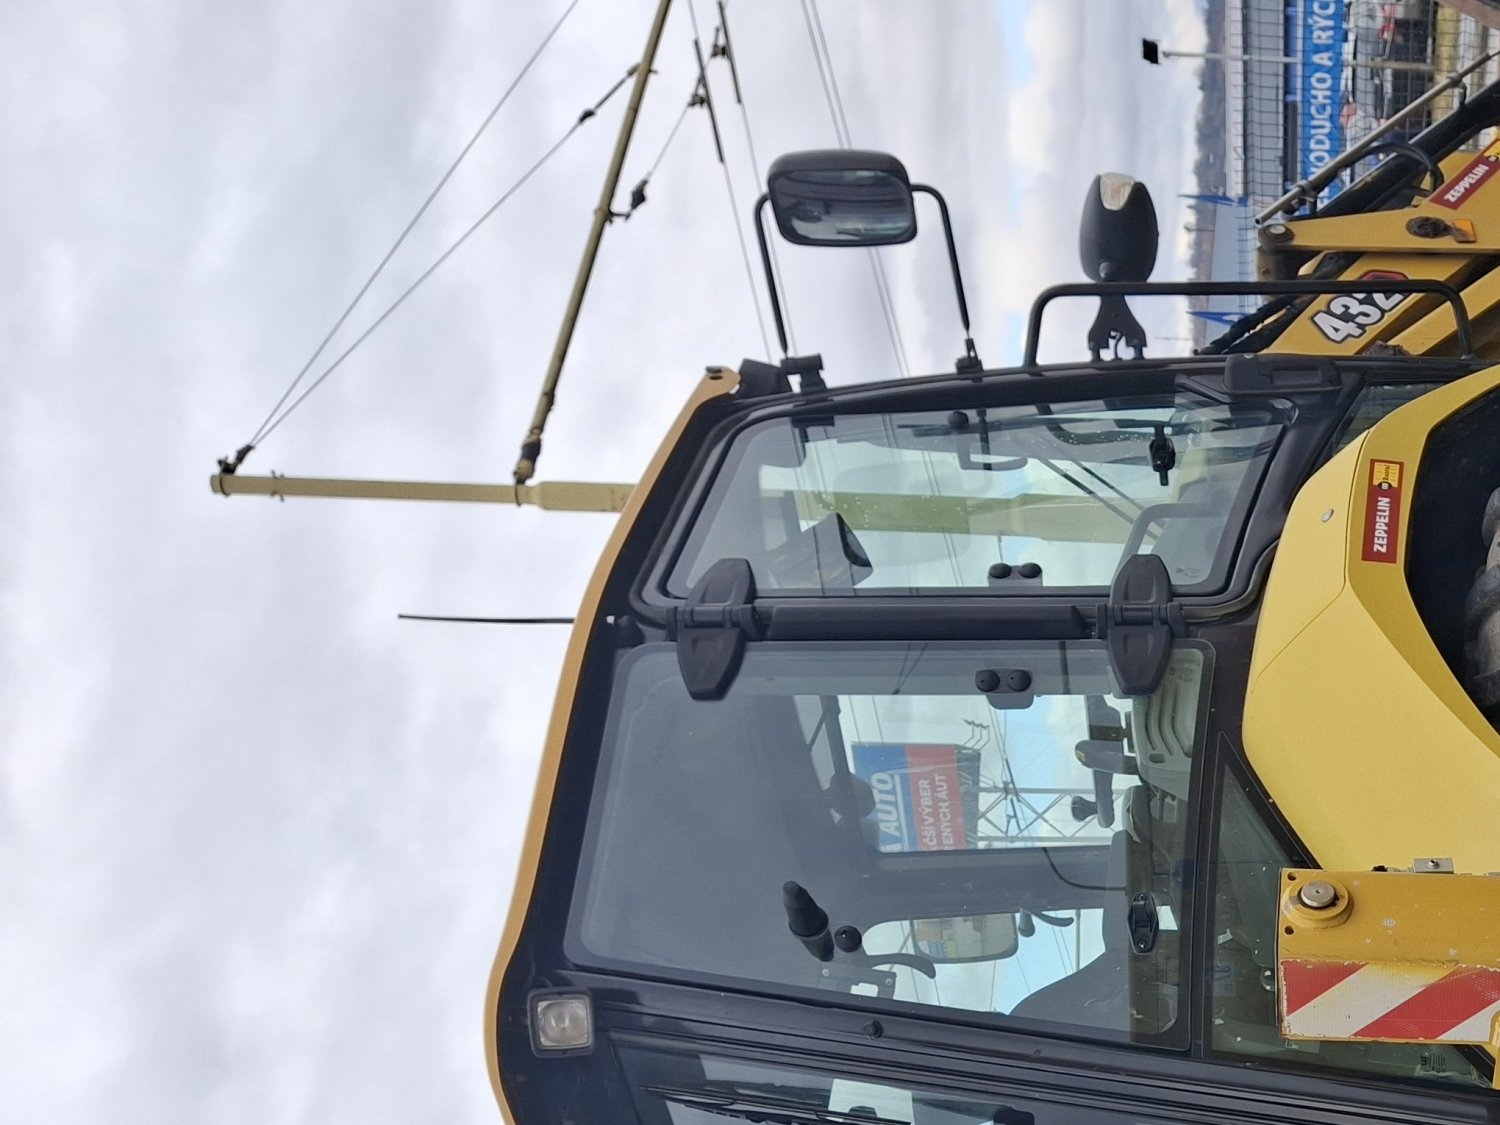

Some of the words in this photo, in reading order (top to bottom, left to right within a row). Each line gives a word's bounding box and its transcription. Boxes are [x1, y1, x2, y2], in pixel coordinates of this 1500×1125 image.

[1308, 0, 1336, 44] RÝC
[1311, 52, 1334, 66] A
[1442, 163, 1490, 202] ZEPPELIN
[1373, 496, 1391, 553] ZEPPELIN
[871, 772, 901, 837] AUTO
[918, 779, 934, 825] VÝBER
